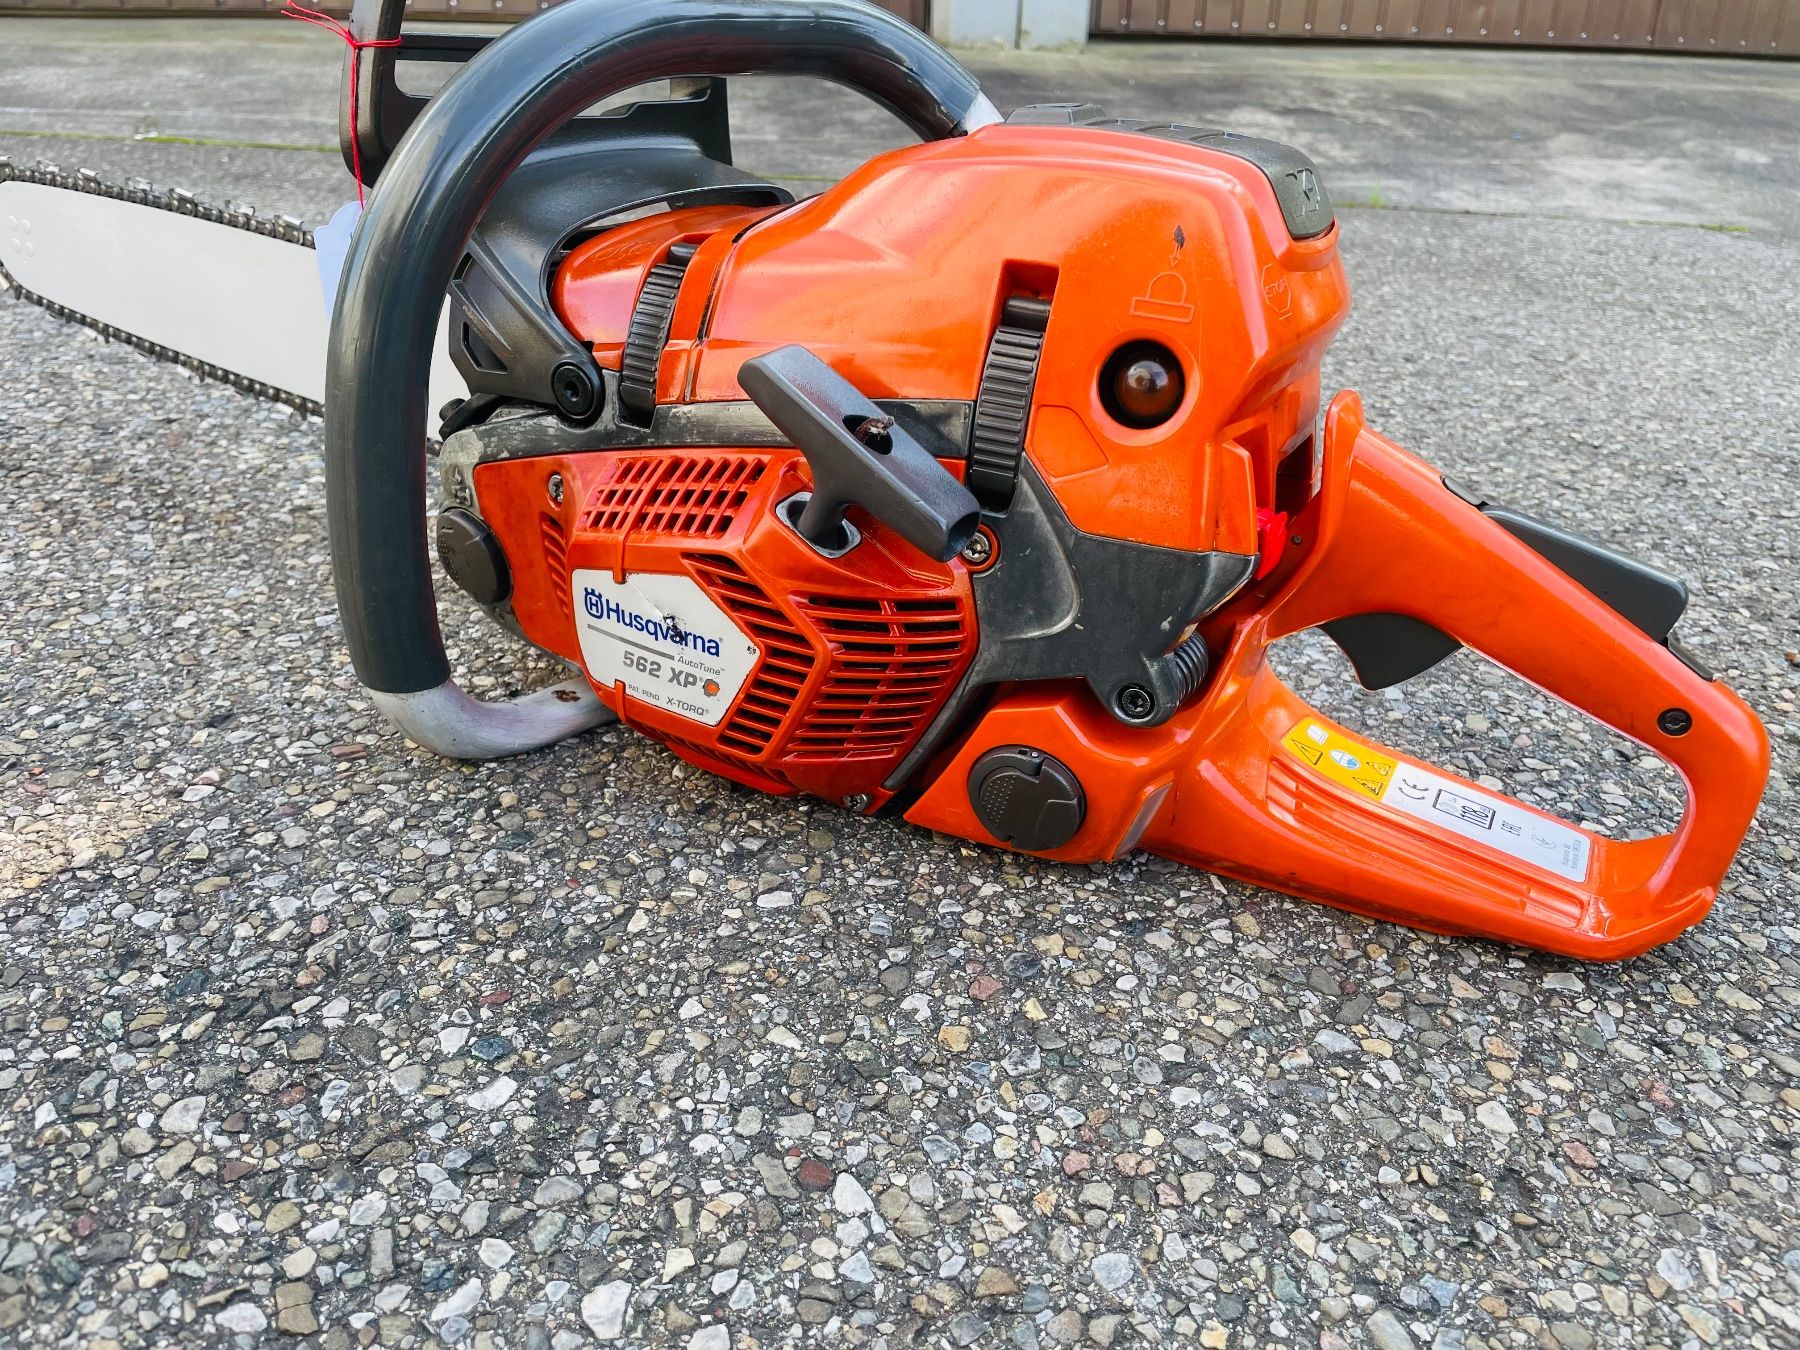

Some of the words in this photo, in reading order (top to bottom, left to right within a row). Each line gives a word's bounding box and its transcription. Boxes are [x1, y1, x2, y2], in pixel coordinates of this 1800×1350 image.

[605, 598, 720, 657] Husqvarna
[623, 650, 662, 679] 562
[668, 667, 698, 688] XP
[1398, 778, 1430, 800] CE
[1460, 805, 1490, 826] 118
